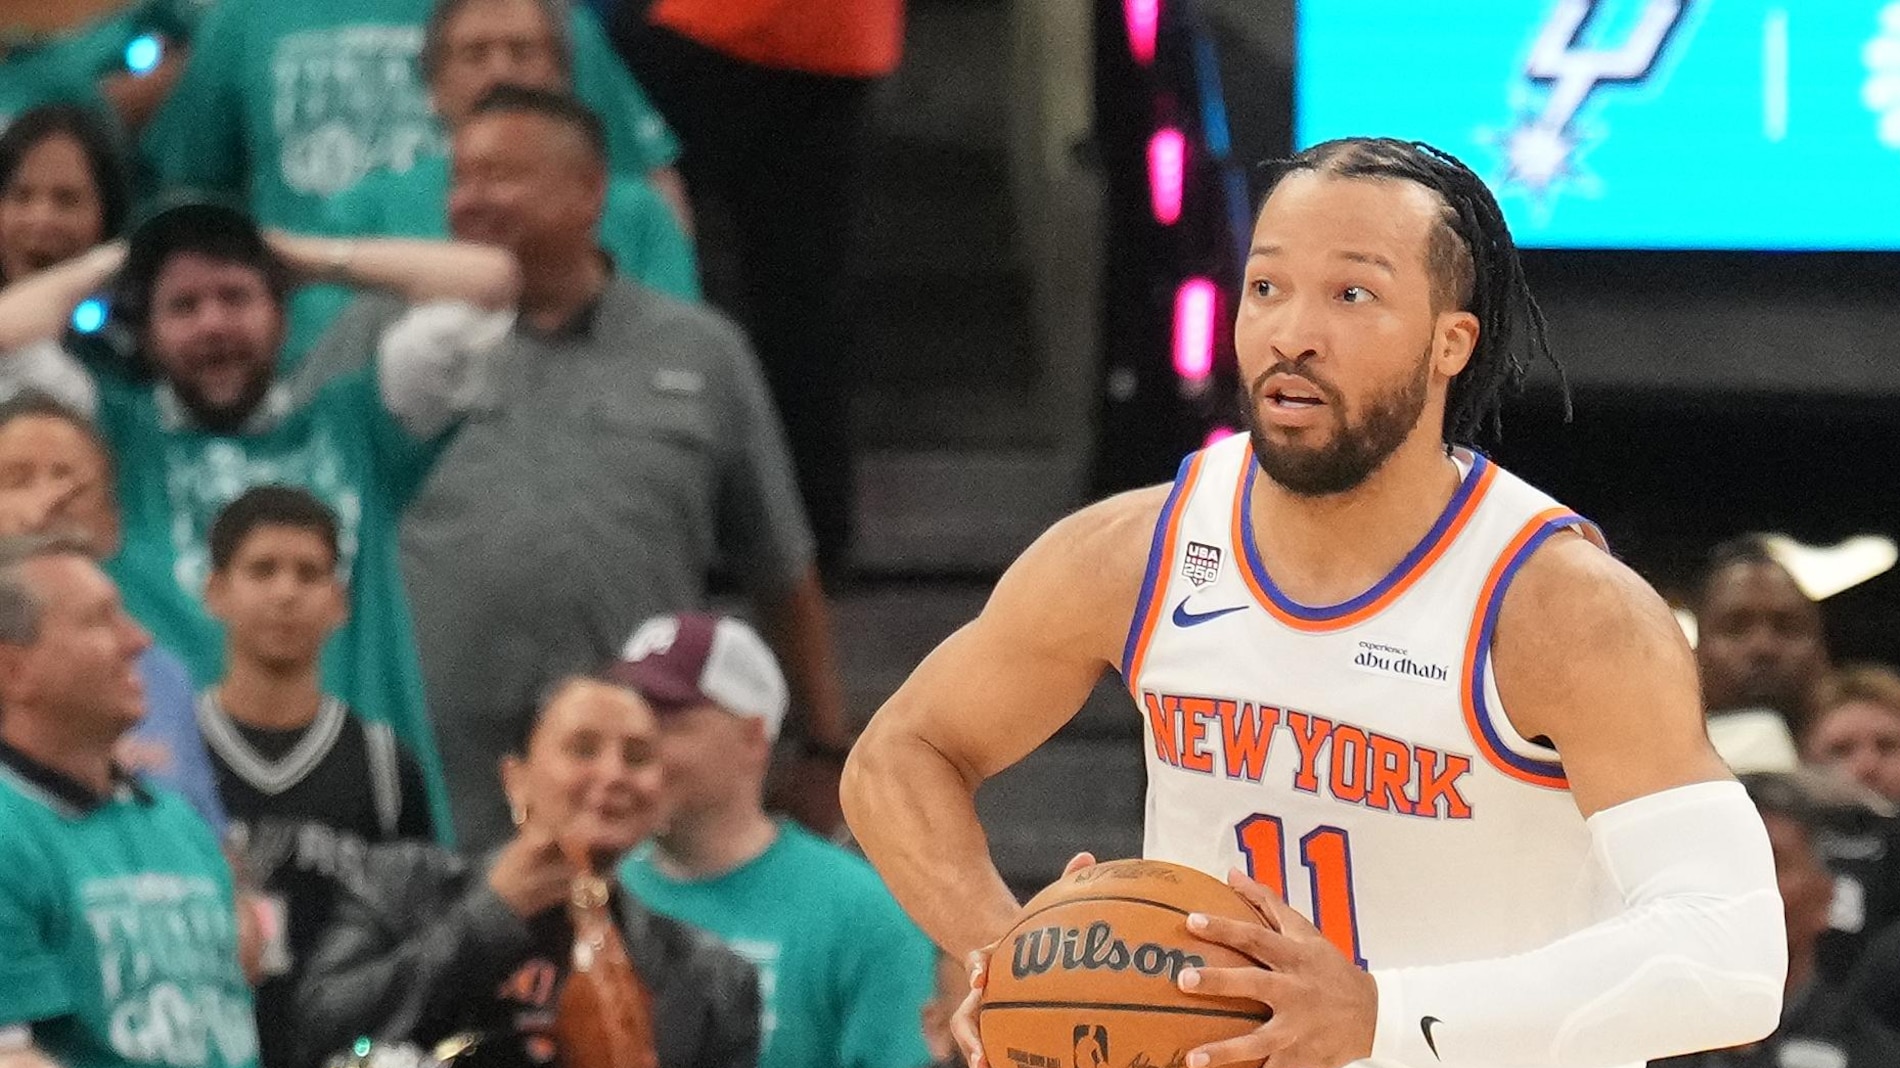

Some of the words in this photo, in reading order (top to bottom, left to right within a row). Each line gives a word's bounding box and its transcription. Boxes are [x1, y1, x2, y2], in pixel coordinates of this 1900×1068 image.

[1188, 544, 1219, 562] USA
[1183, 563, 1218, 582] 250
[1358, 641, 1408, 656] experience
[1354, 652, 1390, 671] abu
[1393, 658, 1449, 681] dhabi
[1144, 691, 1280, 783] NEW
[1286, 709, 1473, 820] YORK
[1234, 812, 1368, 971] 11
[1012, 920, 1205, 982] Wilson
